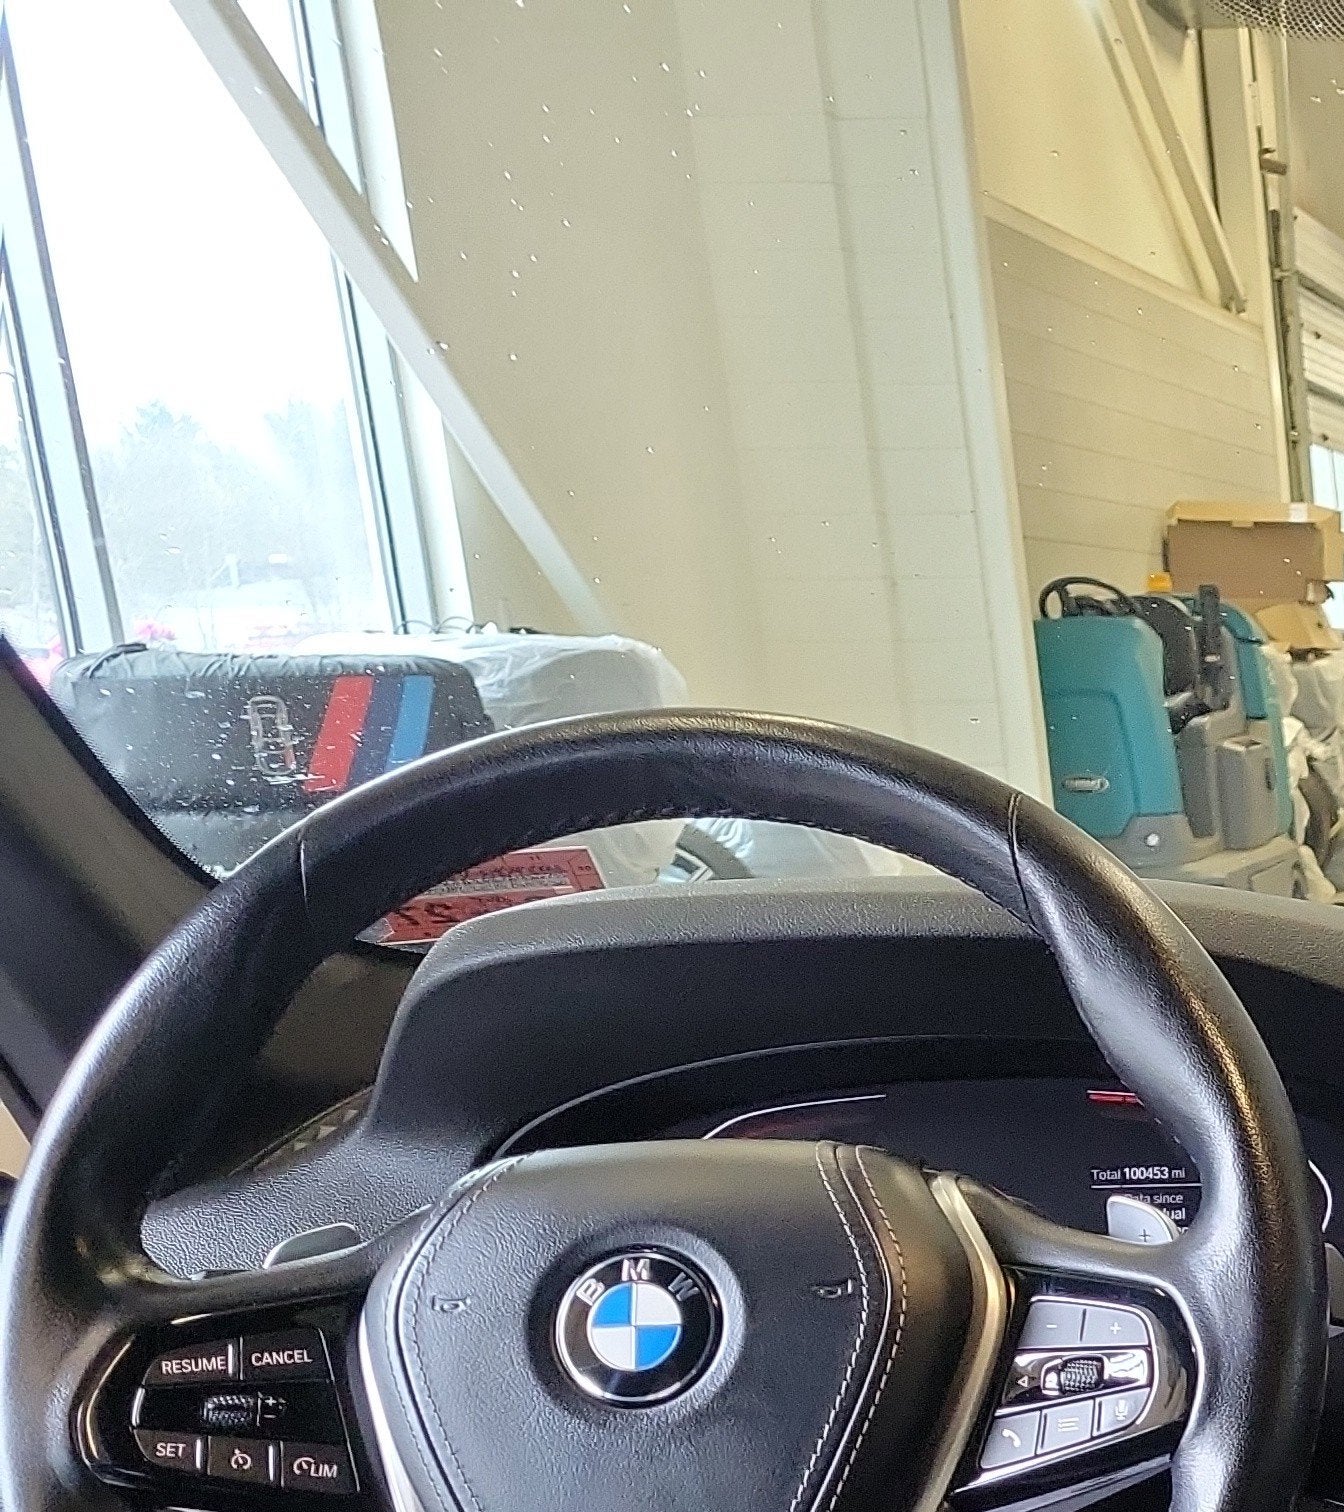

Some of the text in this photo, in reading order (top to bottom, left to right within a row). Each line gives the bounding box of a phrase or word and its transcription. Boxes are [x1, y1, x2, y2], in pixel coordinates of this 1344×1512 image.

[1091, 1166, 1186, 1181] Total 100453 mi
[1152, 1193, 1184, 1205] since
[576, 1258, 699, 1307] BMW
[161, 1356, 227, 1375] RESUME
[251, 1349, 313, 1367] CANCEL
[155, 1443, 187, 1458] SET
[308, 1463, 338, 1478] LIM
